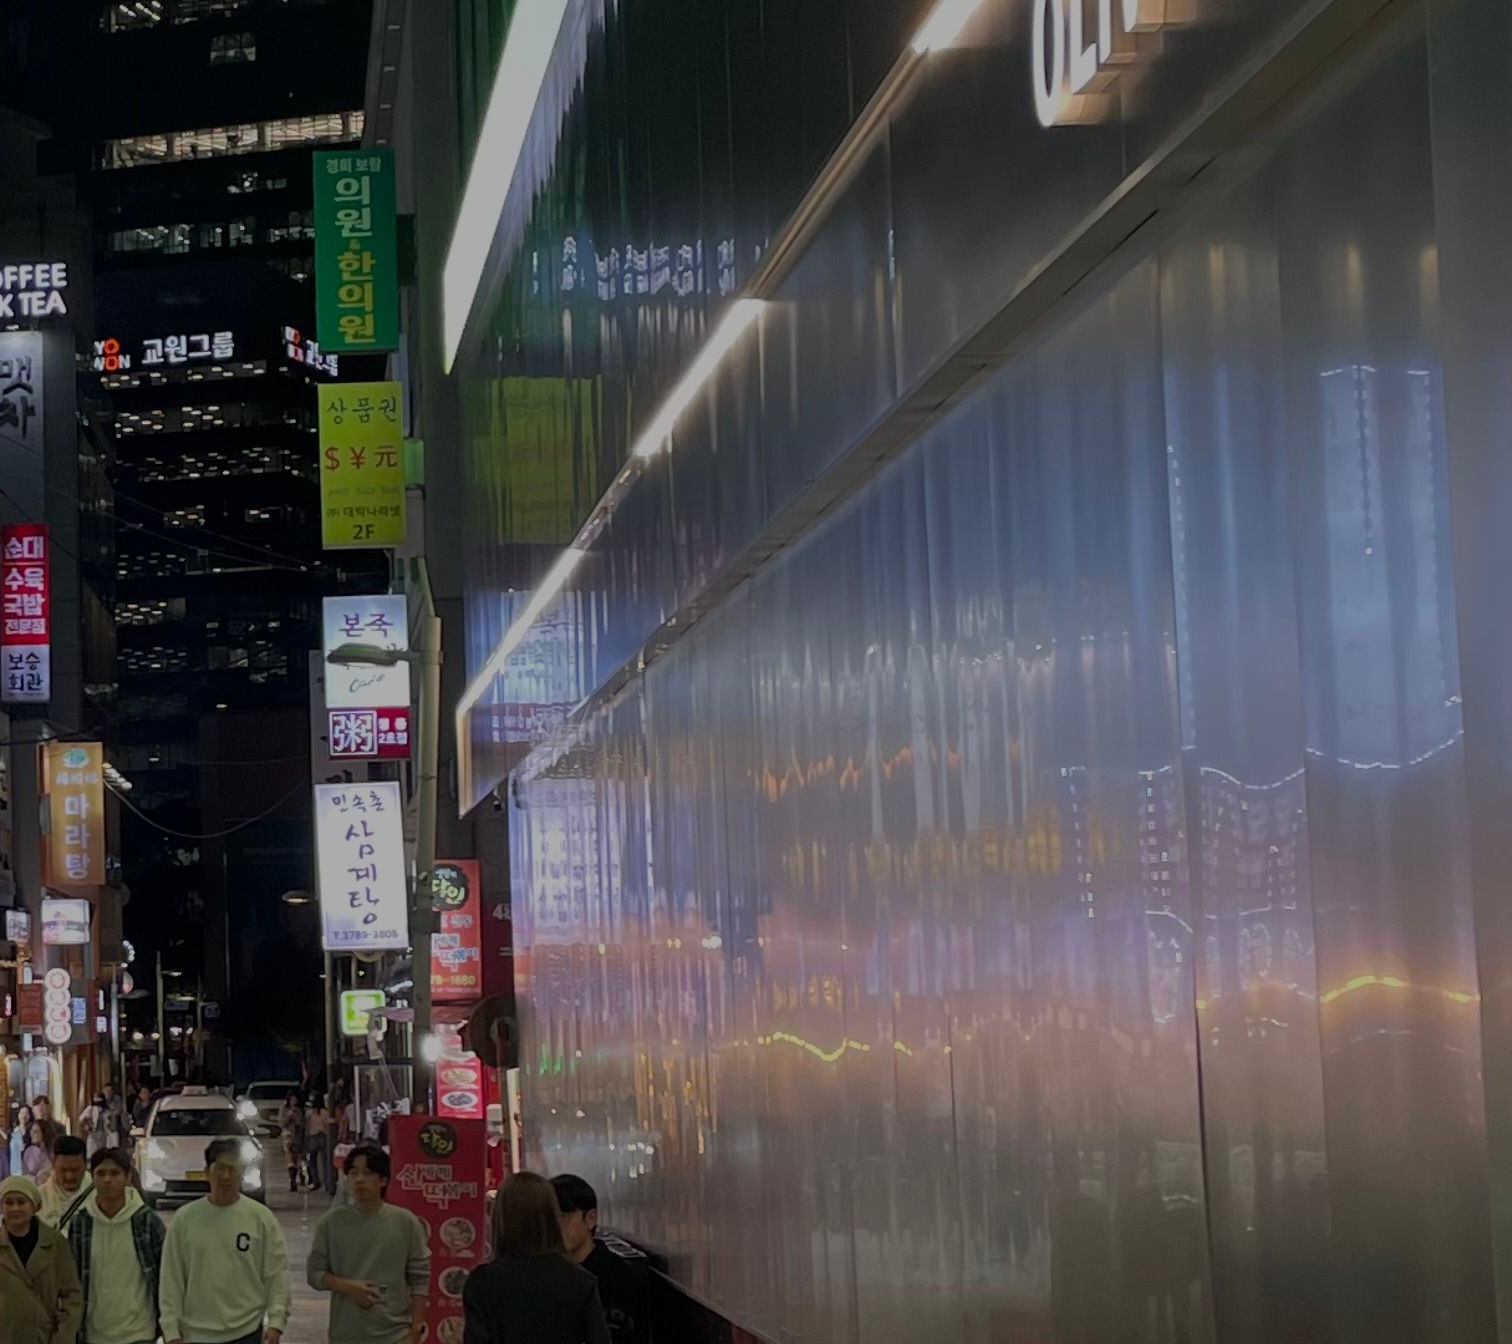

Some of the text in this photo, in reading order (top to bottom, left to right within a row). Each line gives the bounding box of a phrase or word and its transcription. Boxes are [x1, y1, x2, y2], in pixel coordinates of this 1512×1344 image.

[335, 176, 372, 238] 의원
[18, 290, 68, 316] TEA
[338, 250, 376, 345] 한의원
[141, 332, 232, 366] 교원그룹
[352, 524, 376, 540] 2F
[65, 794, 90, 879] 마라탕
[345, 820, 380, 925] 삼계탕
[237, 1233, 251, 1252] C
